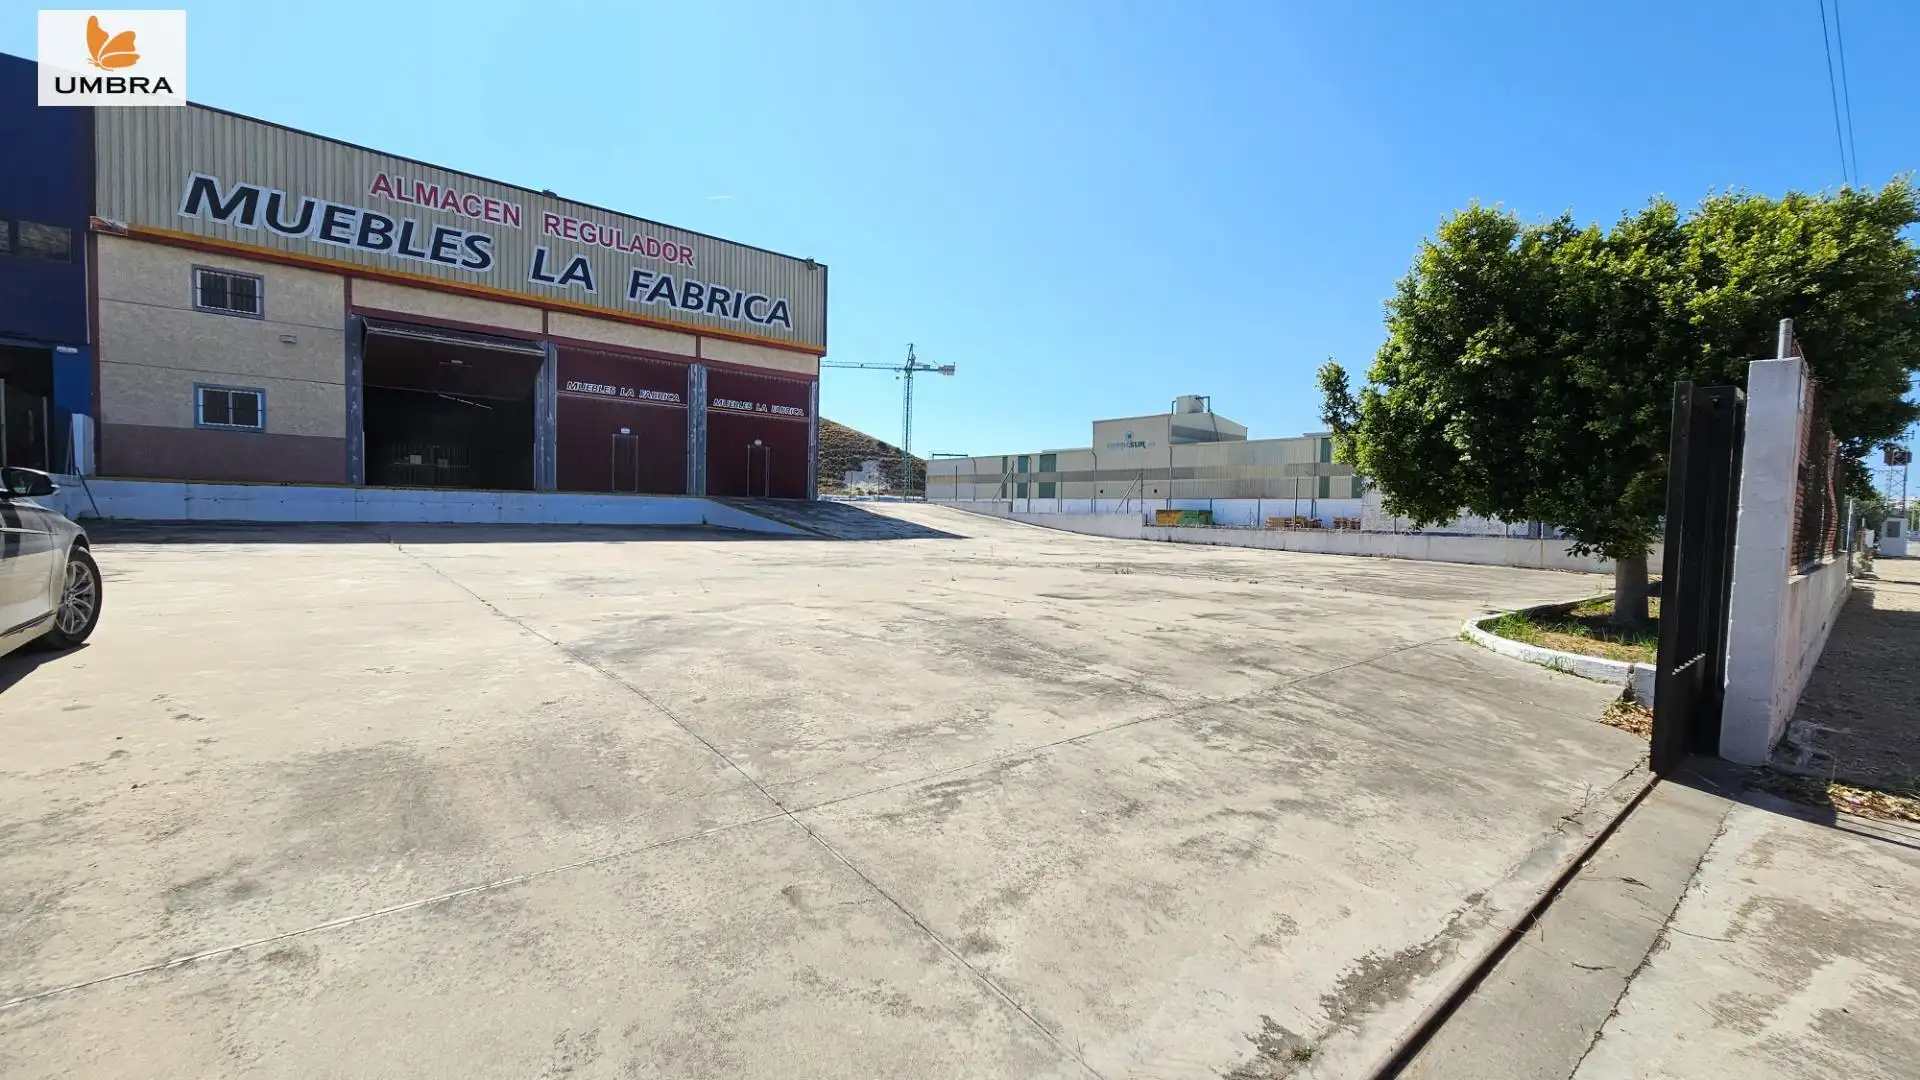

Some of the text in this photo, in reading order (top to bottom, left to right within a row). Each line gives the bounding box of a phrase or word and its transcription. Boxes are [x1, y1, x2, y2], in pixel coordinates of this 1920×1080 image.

[370, 172, 694, 266] ALMACEN REGULADOR
[182, 174, 792, 329] MUEBLES LA FABRICA
[566, 381, 680, 402] MUEBLES LA FABRICA
[755, 403, 768, 412] LA
